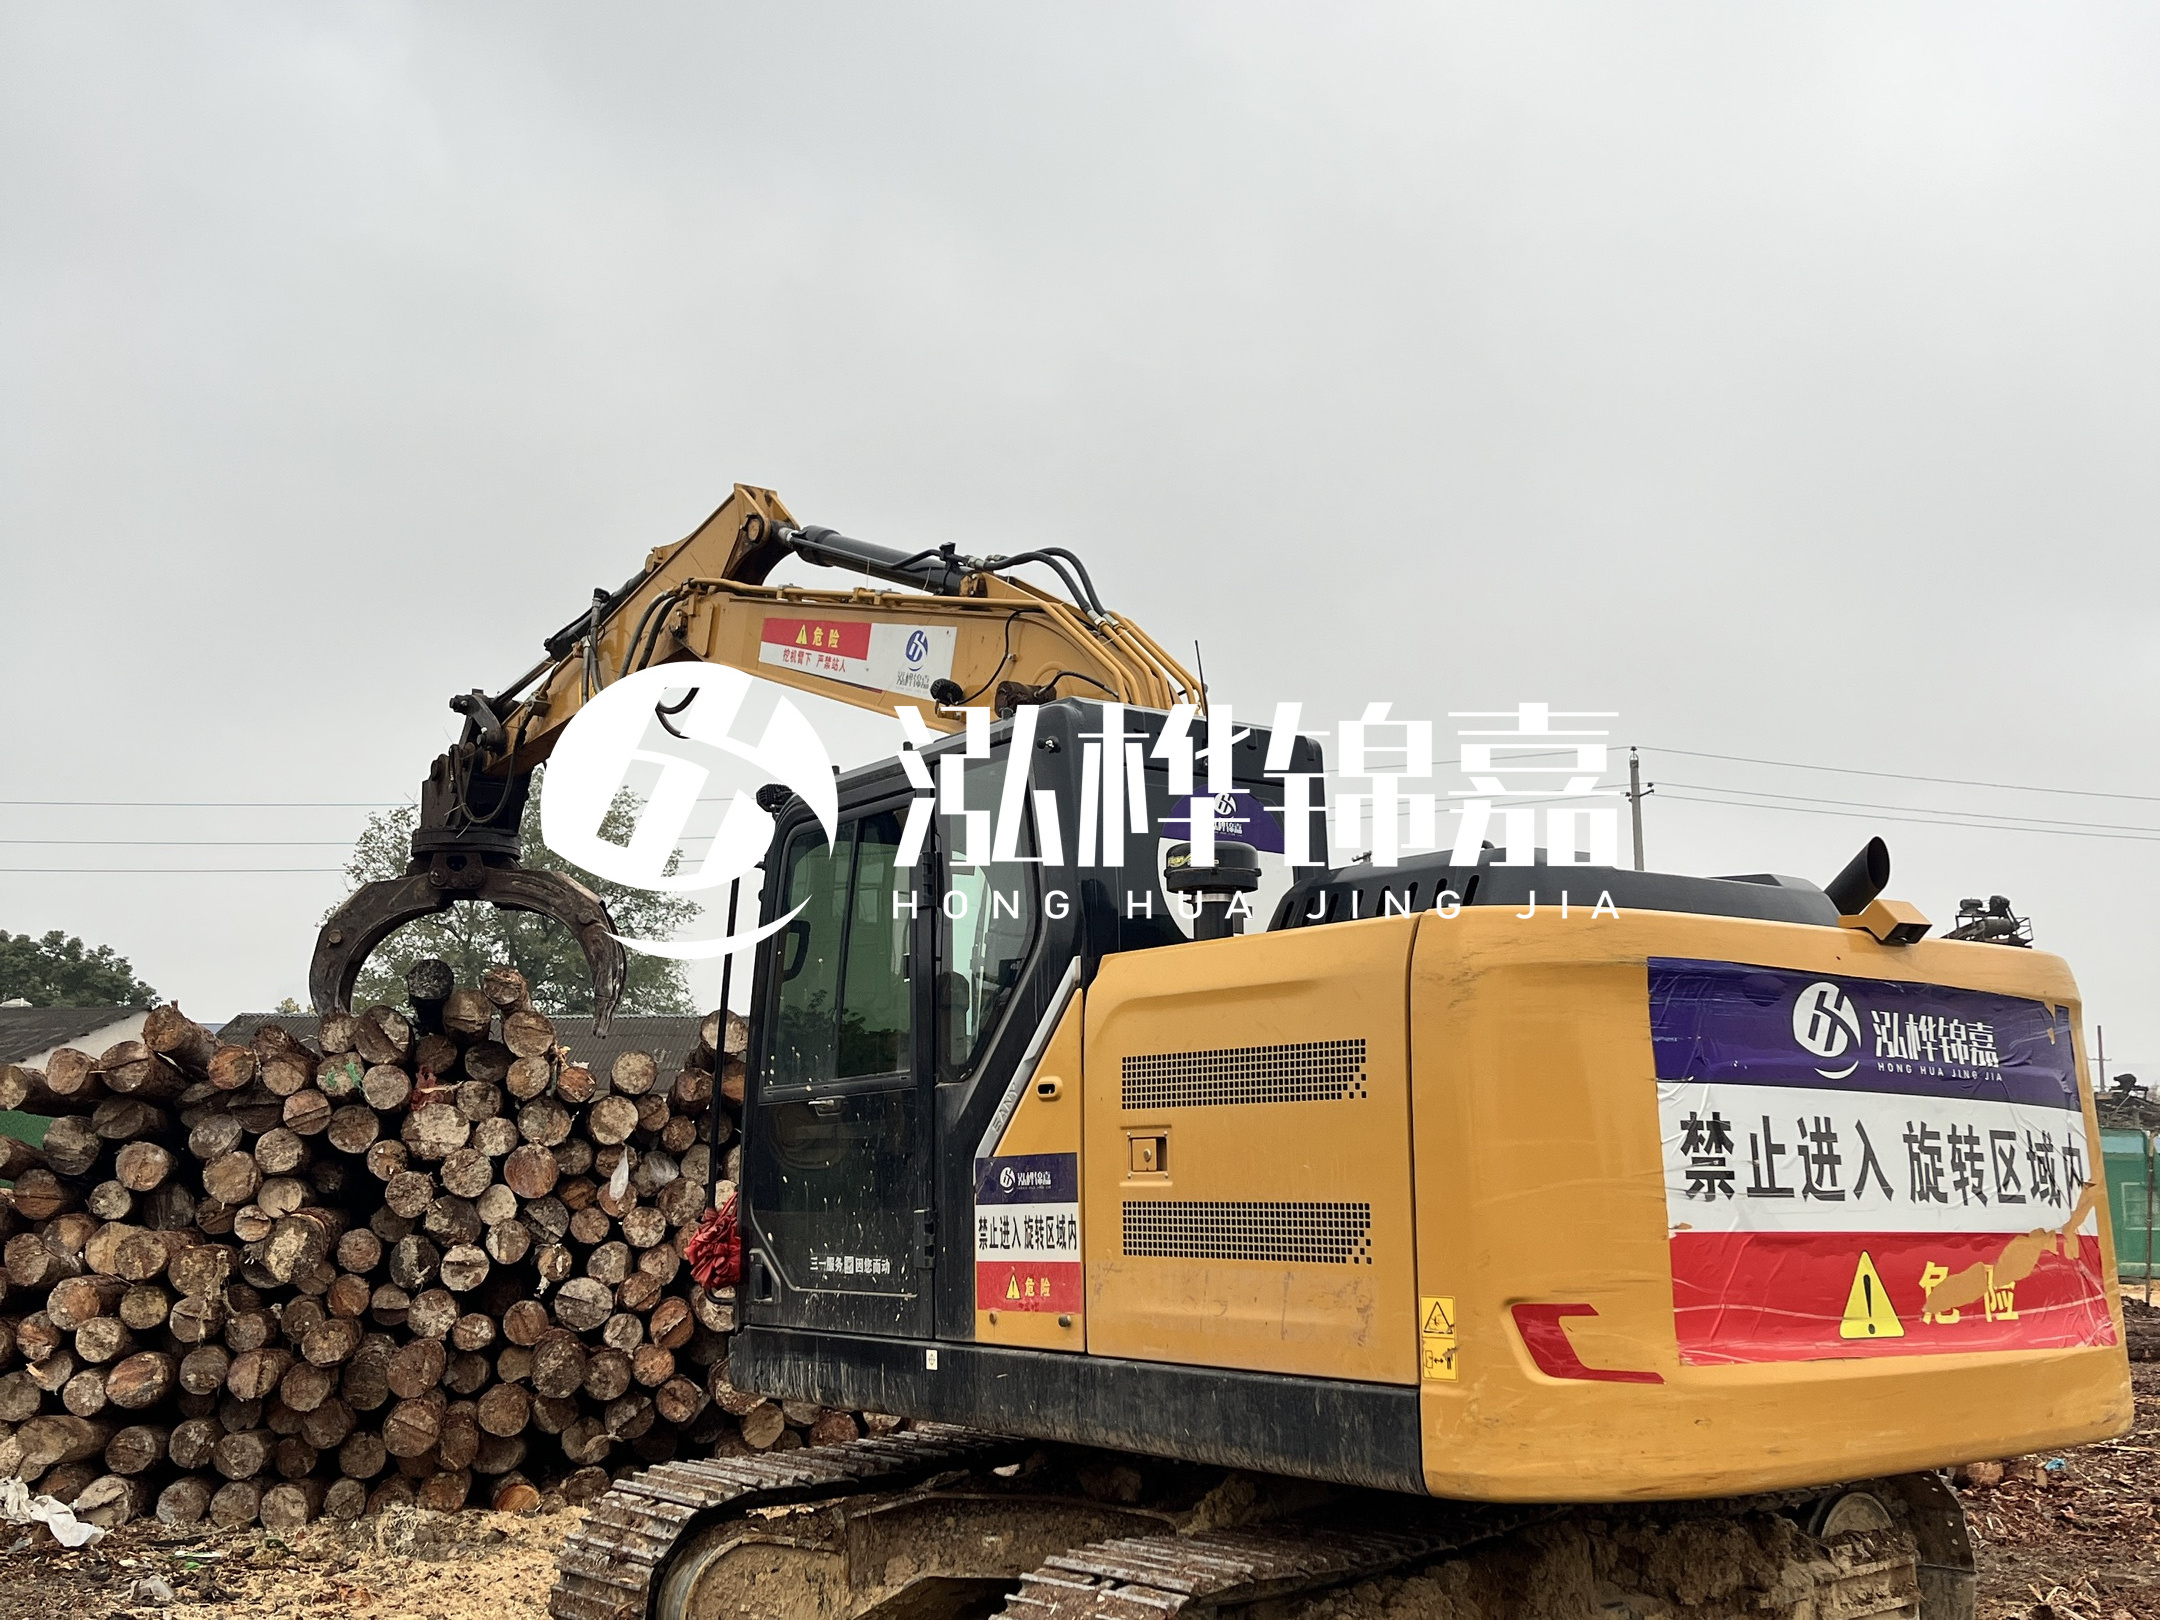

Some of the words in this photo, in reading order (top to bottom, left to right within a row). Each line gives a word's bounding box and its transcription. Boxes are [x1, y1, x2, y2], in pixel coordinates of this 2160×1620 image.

[812, 626, 840, 648] 危险
[1872, 1010, 2000, 1068] 泓桦锦嘉
[1877, 1062, 1913, 1074] HONG
[1920, 1066, 1944, 1076] HUA
[1952, 1069, 1978, 1080] JING
[1985, 1072, 2003, 1081] JIA
[991, 1082, 1019, 1134] SANY
[1024, 1276, 1051, 1297] 危险
